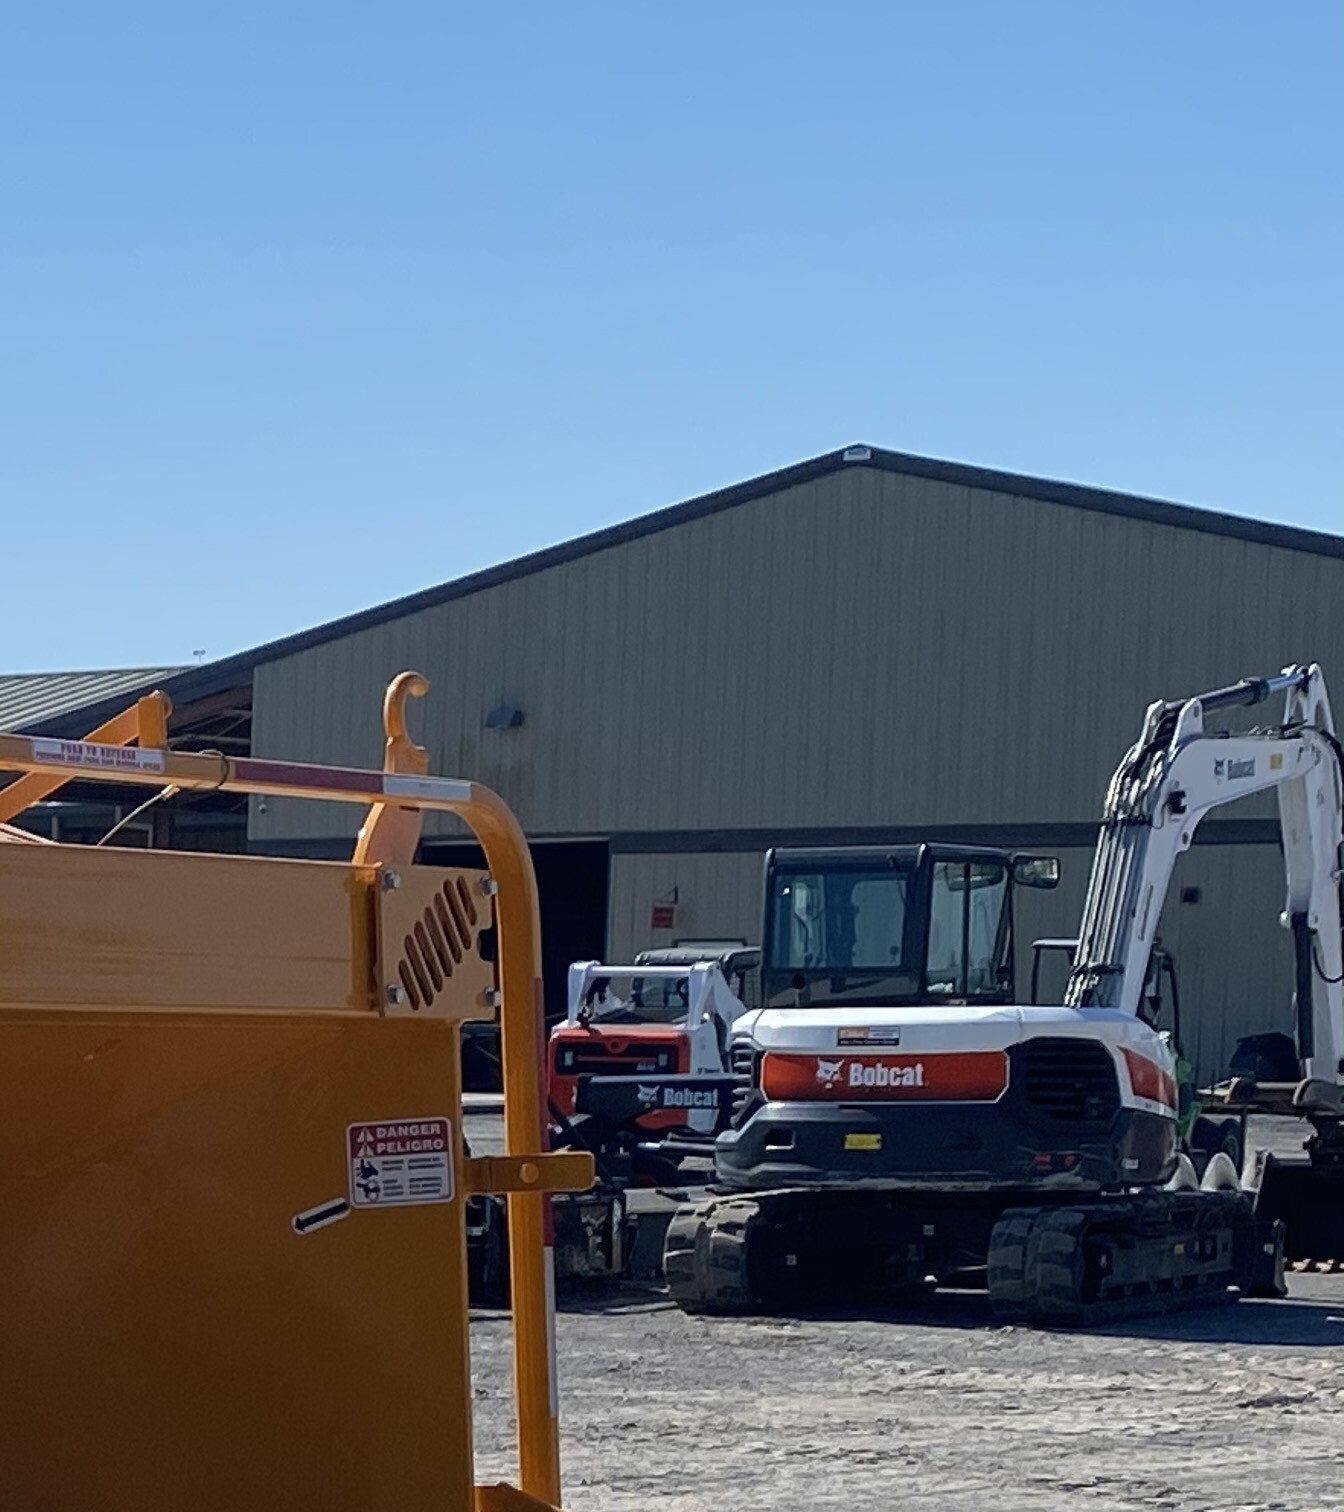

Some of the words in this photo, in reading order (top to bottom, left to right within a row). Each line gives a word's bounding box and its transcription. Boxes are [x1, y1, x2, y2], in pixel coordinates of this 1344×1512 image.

[849, 1062, 924, 1087] Bobcat
[663, 1087, 719, 1107] Bobcat
[376, 1123, 441, 1139] DANGER
[376, 1139, 445, 1154] PELIGRO
